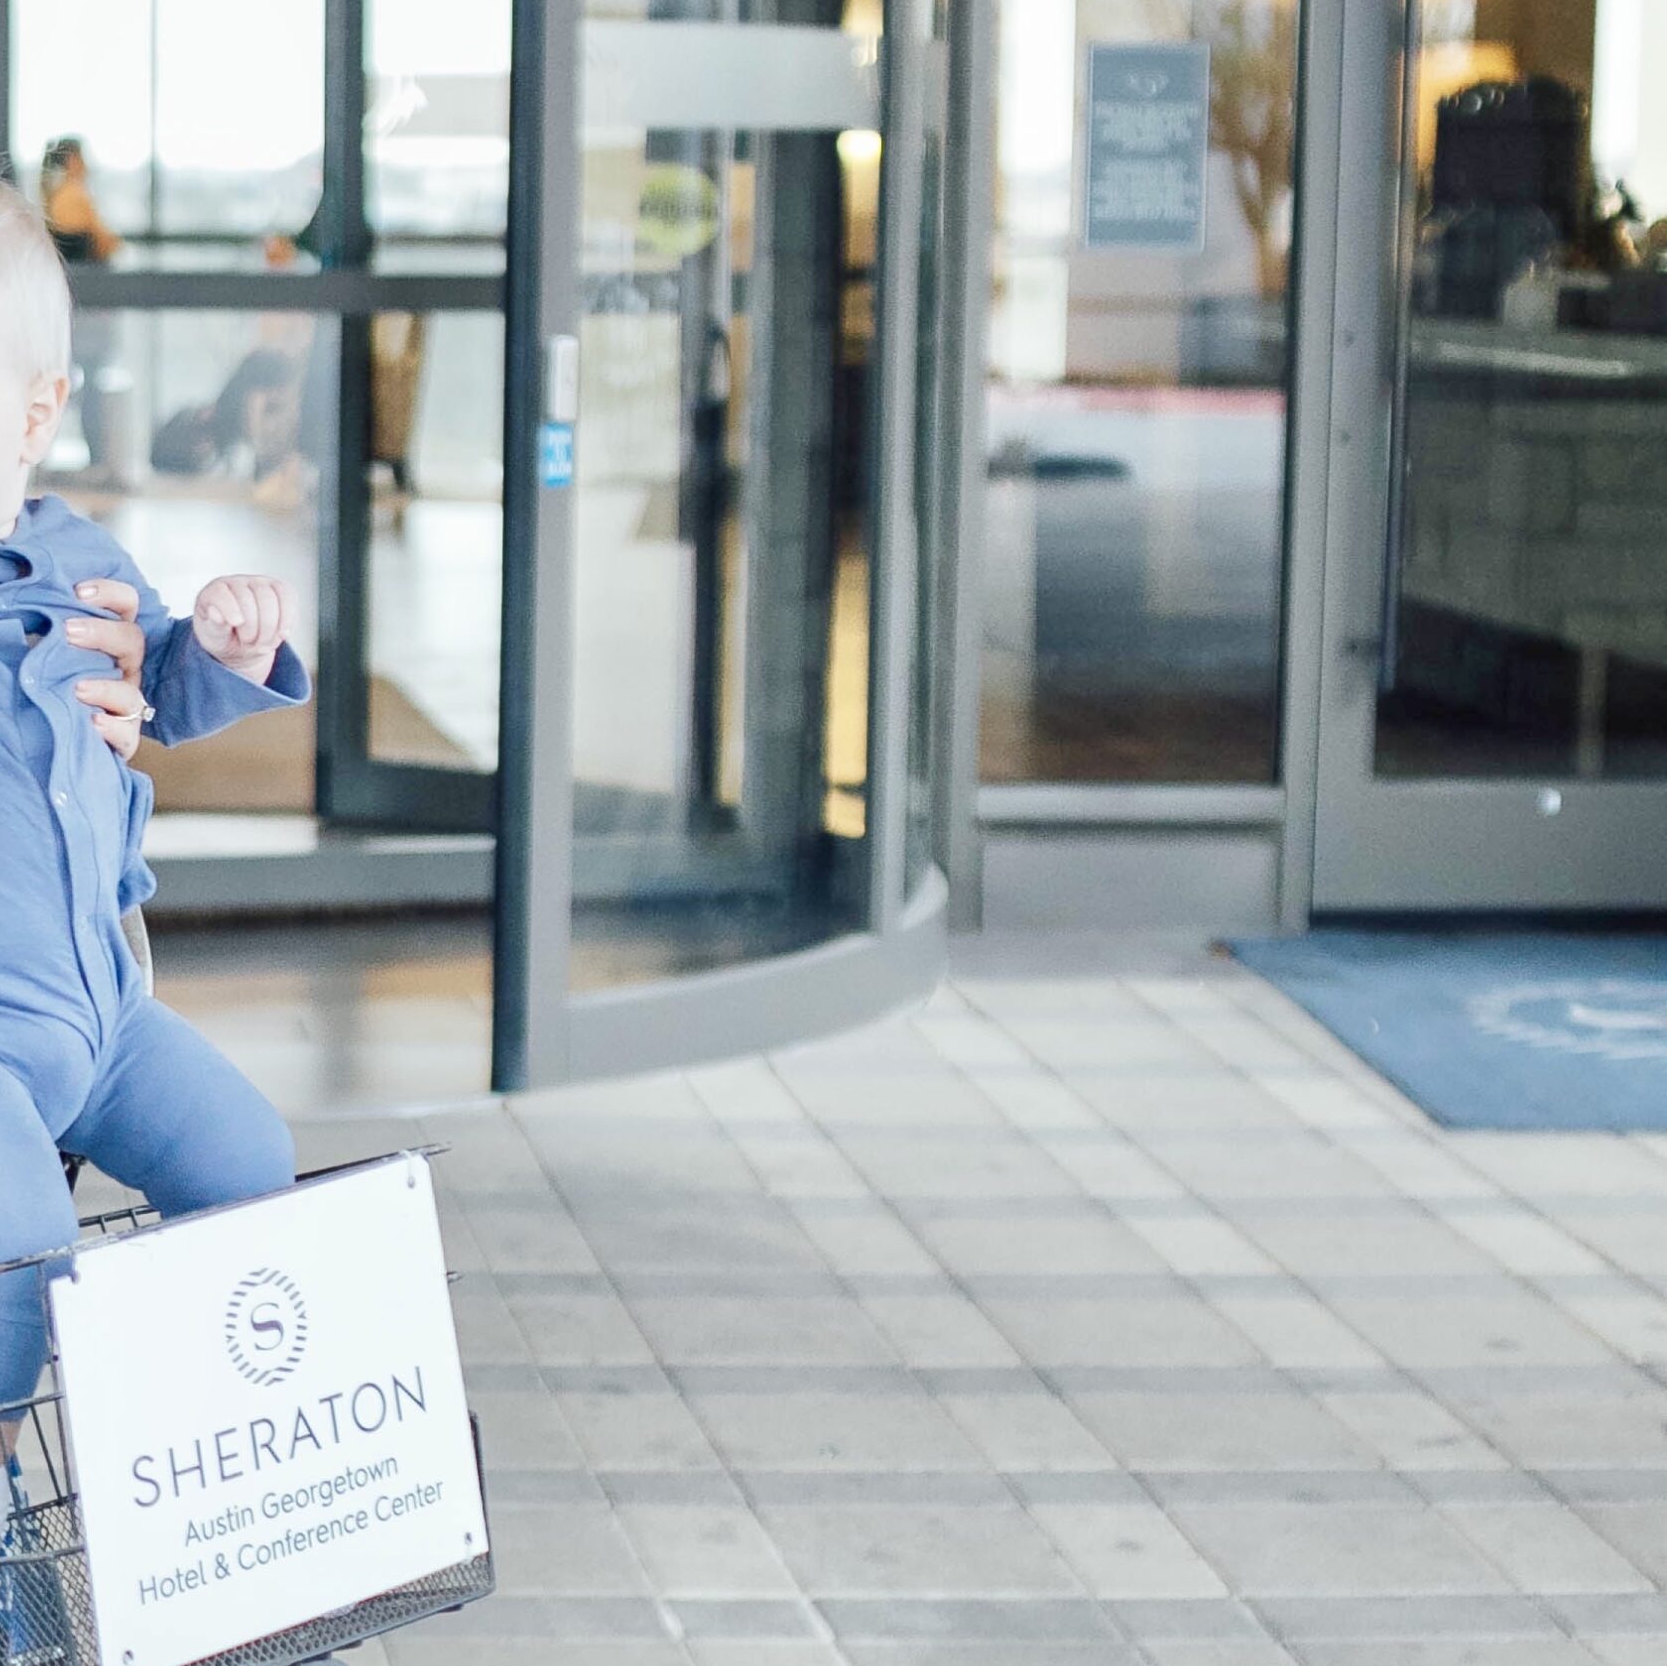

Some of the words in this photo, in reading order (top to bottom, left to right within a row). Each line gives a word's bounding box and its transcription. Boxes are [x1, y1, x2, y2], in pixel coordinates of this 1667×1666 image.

[131, 1365, 428, 1509] SHERATON
[138, 1558, 209, 1606] Hotel
[213, 1551, 232, 1581] &
[236, 1507, 370, 1572] Conference
[374, 1481, 444, 1523] Center
[183, 1505, 256, 1548] Austin
[260, 1455, 399, 1520] Georgetown
